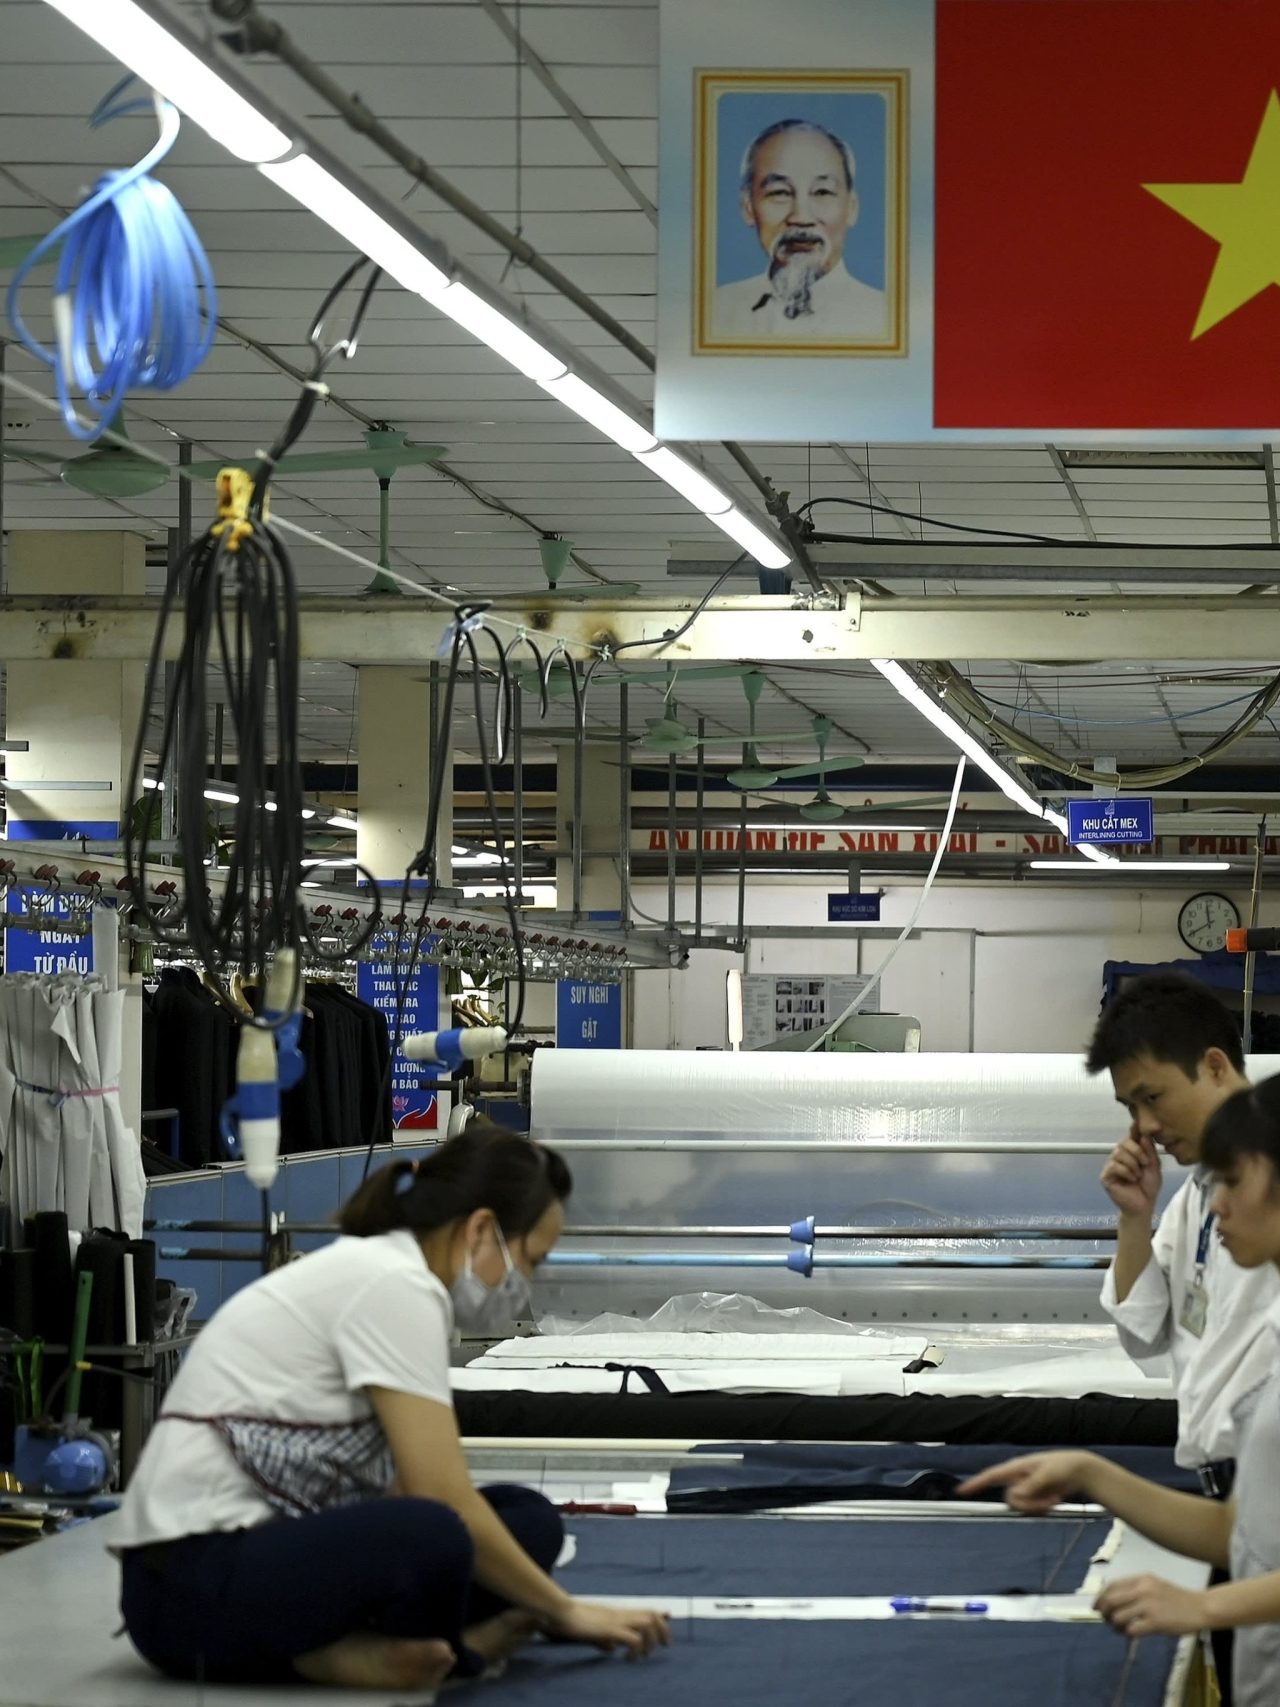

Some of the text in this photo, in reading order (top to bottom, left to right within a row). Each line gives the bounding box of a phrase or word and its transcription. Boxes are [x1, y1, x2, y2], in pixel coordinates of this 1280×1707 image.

[1082, 814, 1138, 830] KHU CẮT MEX
[34, 952, 55, 974] TỪ
[402, 998, 419, 1008] RA
[571, 986, 586, 1004] SUY
